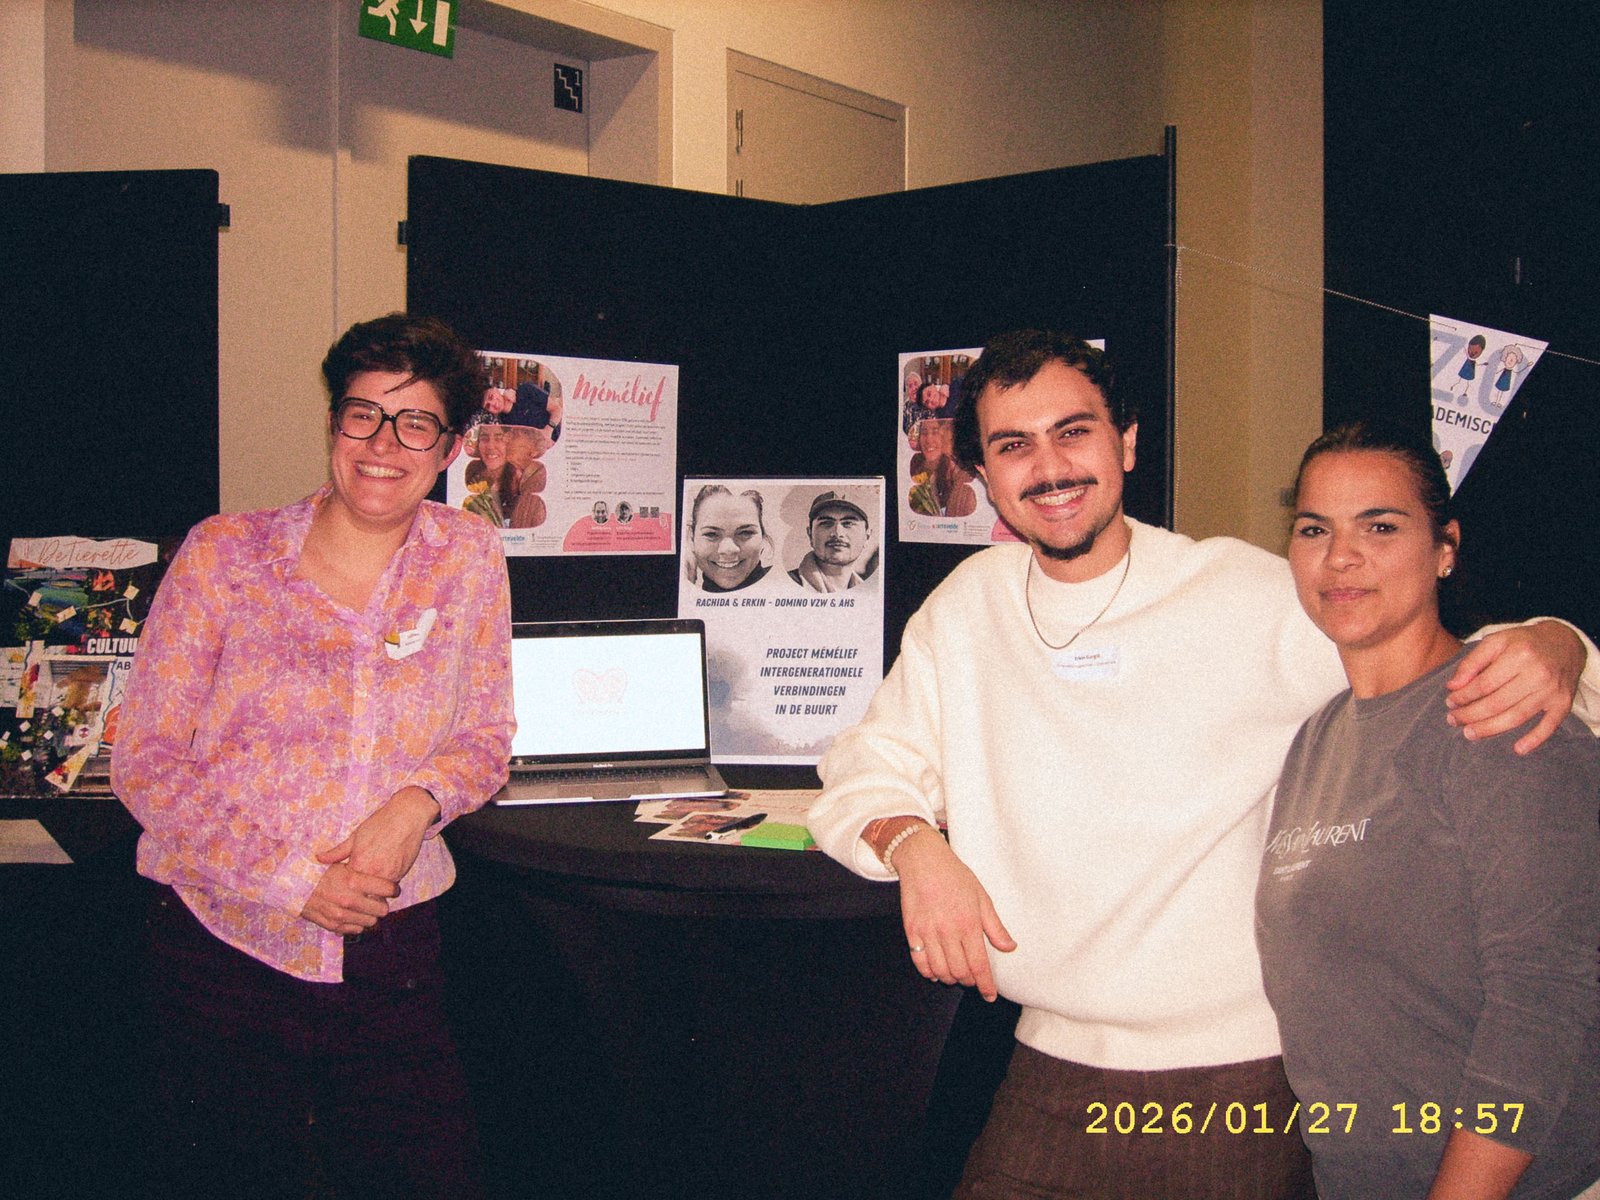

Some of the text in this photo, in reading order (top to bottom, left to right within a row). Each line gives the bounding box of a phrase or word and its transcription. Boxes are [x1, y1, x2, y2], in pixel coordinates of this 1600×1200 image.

[574, 71, 581, 86] 1
[572, 373, 666, 422] Mémélief
[1433, 405, 1496, 435] DEMISC
[695, 598, 730, 608] RACHIDA
[732, 598, 739, 608] &
[741, 598, 767, 608] ERKIN
[774, 598, 808, 608] DOMINO
[810, 598, 828, 608] VZW
[829, 598, 836, 608] &
[838, 598, 855, 608] AHS
[766, 646, 858, 659] PROJECT MÉMÉLIEF
[760, 667, 864, 678] INTERGENERATIONELE
[773, 685, 846, 696] VERBINDINGEN
[775, 704, 838, 715] IN DE BUURT
